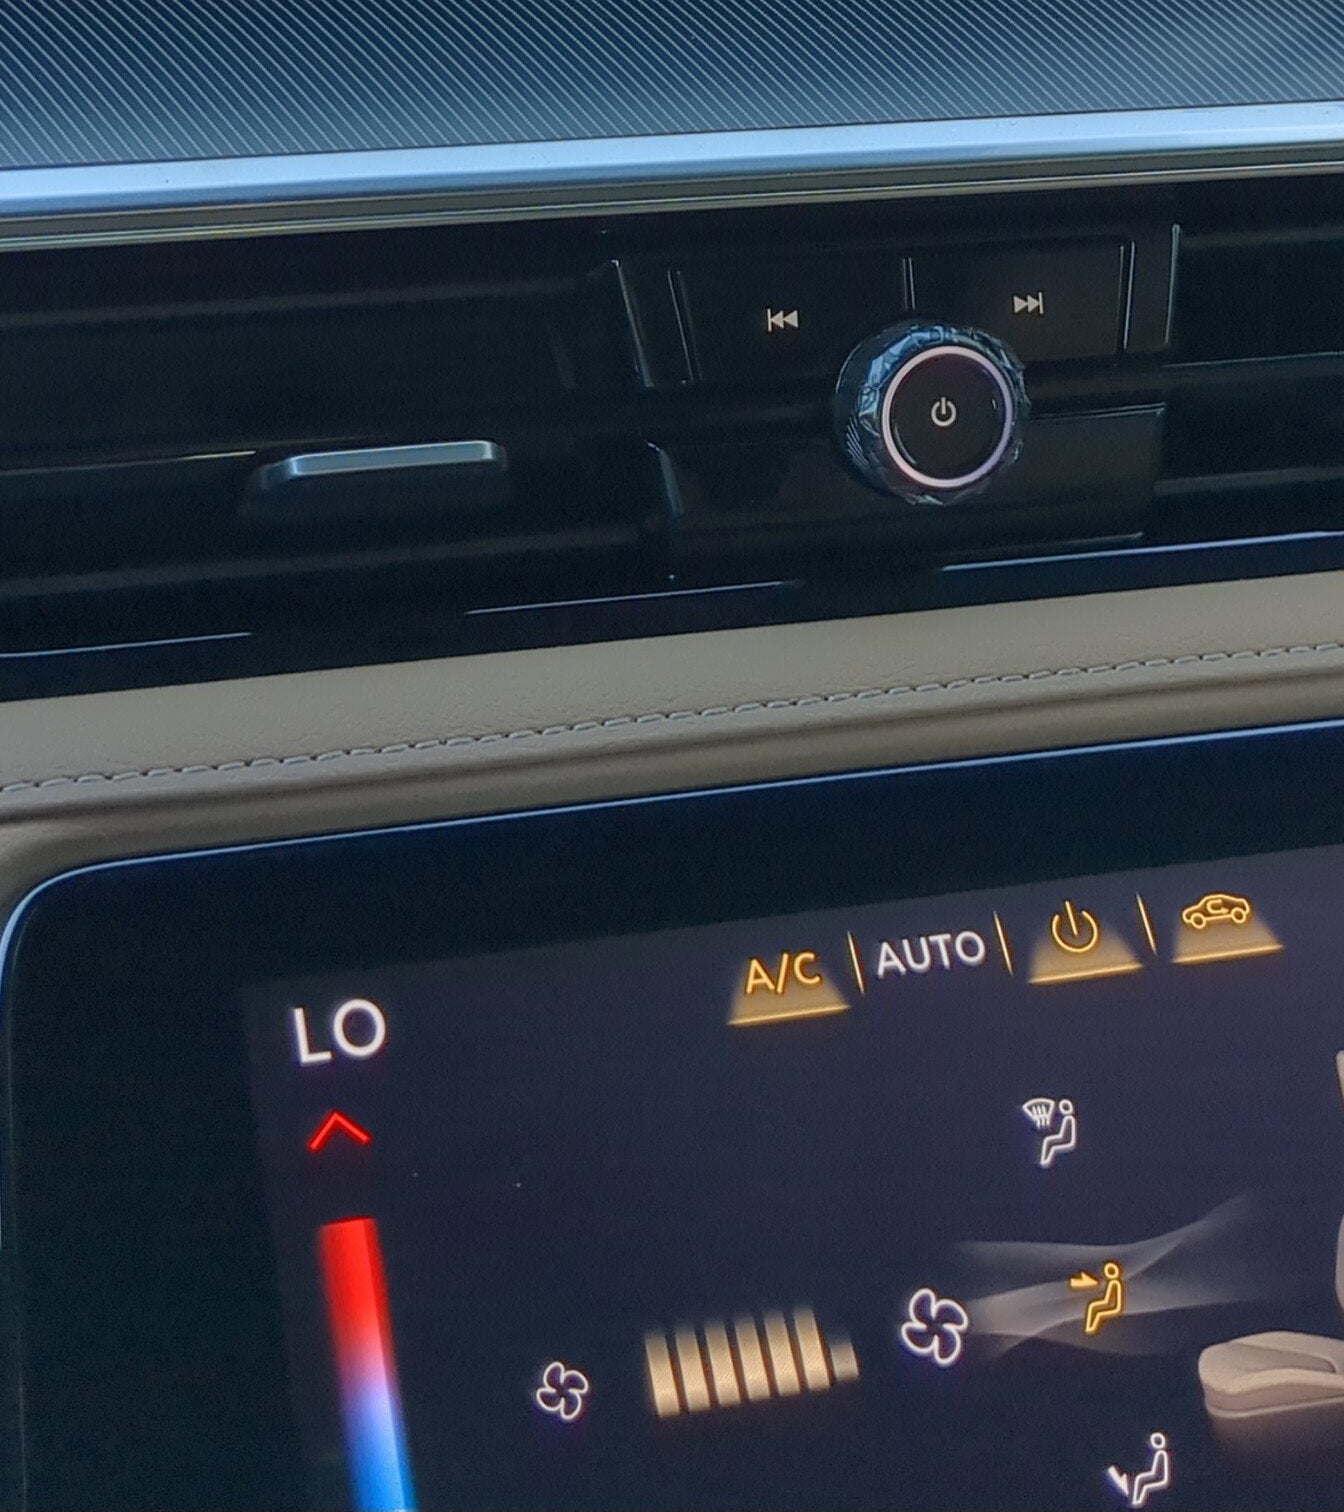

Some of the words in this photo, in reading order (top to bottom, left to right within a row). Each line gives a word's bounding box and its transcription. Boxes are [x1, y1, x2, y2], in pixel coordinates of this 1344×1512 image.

[745, 951, 822, 995] A/C
[876, 930, 987, 977] AUTO
[292, 998, 387, 1065] LO
